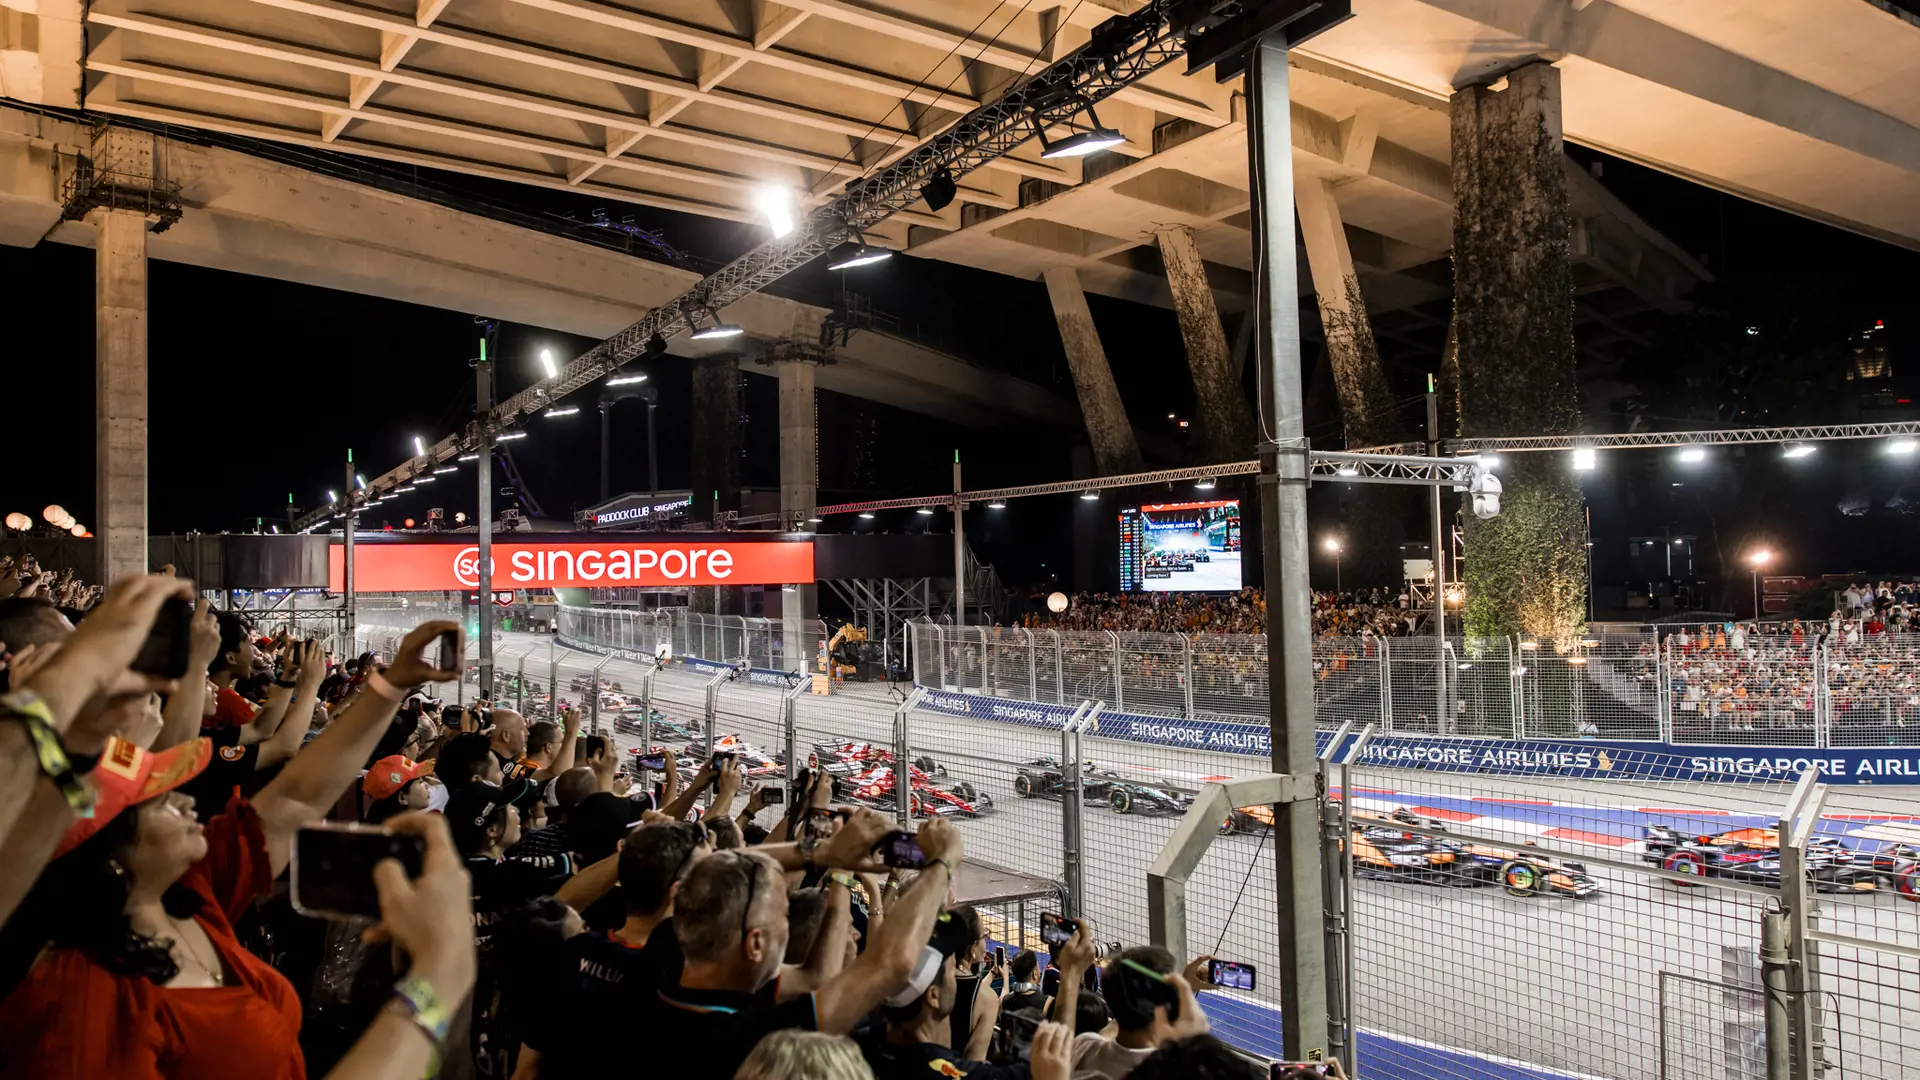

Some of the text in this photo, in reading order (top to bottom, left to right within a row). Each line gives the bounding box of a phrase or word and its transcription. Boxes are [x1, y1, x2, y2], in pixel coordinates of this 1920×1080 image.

[597, 509, 630, 523] PADDOCK
[630, 506, 650, 518] CLUB
[993, 706, 1043, 723] SINGAPORE
[1131, 722, 1272, 750] SINGAPORE AIRLINE
[1481, 749, 1592, 769] AIRLINES
[1691, 756, 1846, 776] SINGAPORE
